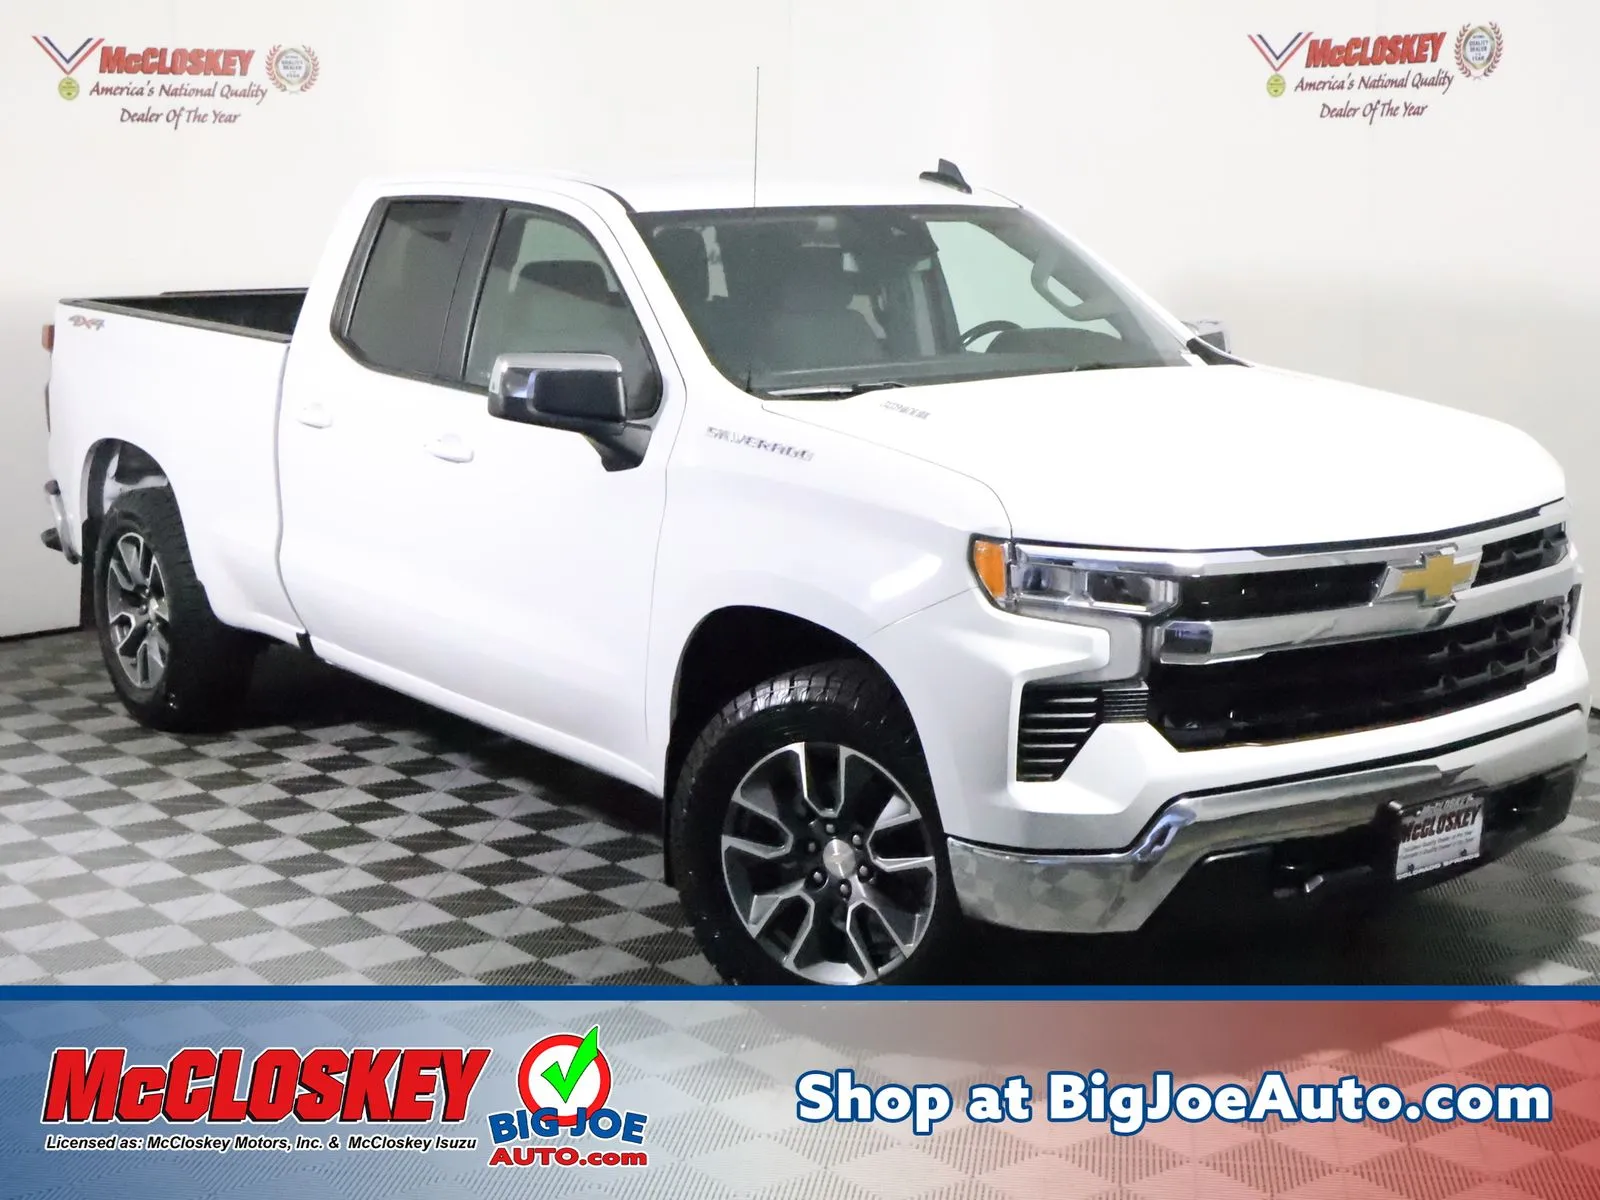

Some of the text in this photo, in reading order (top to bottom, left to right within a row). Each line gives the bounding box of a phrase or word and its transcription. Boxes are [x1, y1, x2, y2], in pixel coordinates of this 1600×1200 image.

[99, 46, 255, 76] McCLOSKEY
[1305, 32, 1447, 68] McCLOSKEY
[89, 81, 155, 97] America's
[158, 82, 216, 98] National
[220, 81, 268, 105] Quality
[1294, 69, 1454, 95] America's National Quality
[120, 107, 241, 130] Dealer Of The Year
[1320, 99, 1428, 125] Dealer Of The Year
[705, 425, 814, 462] SILVERADO
